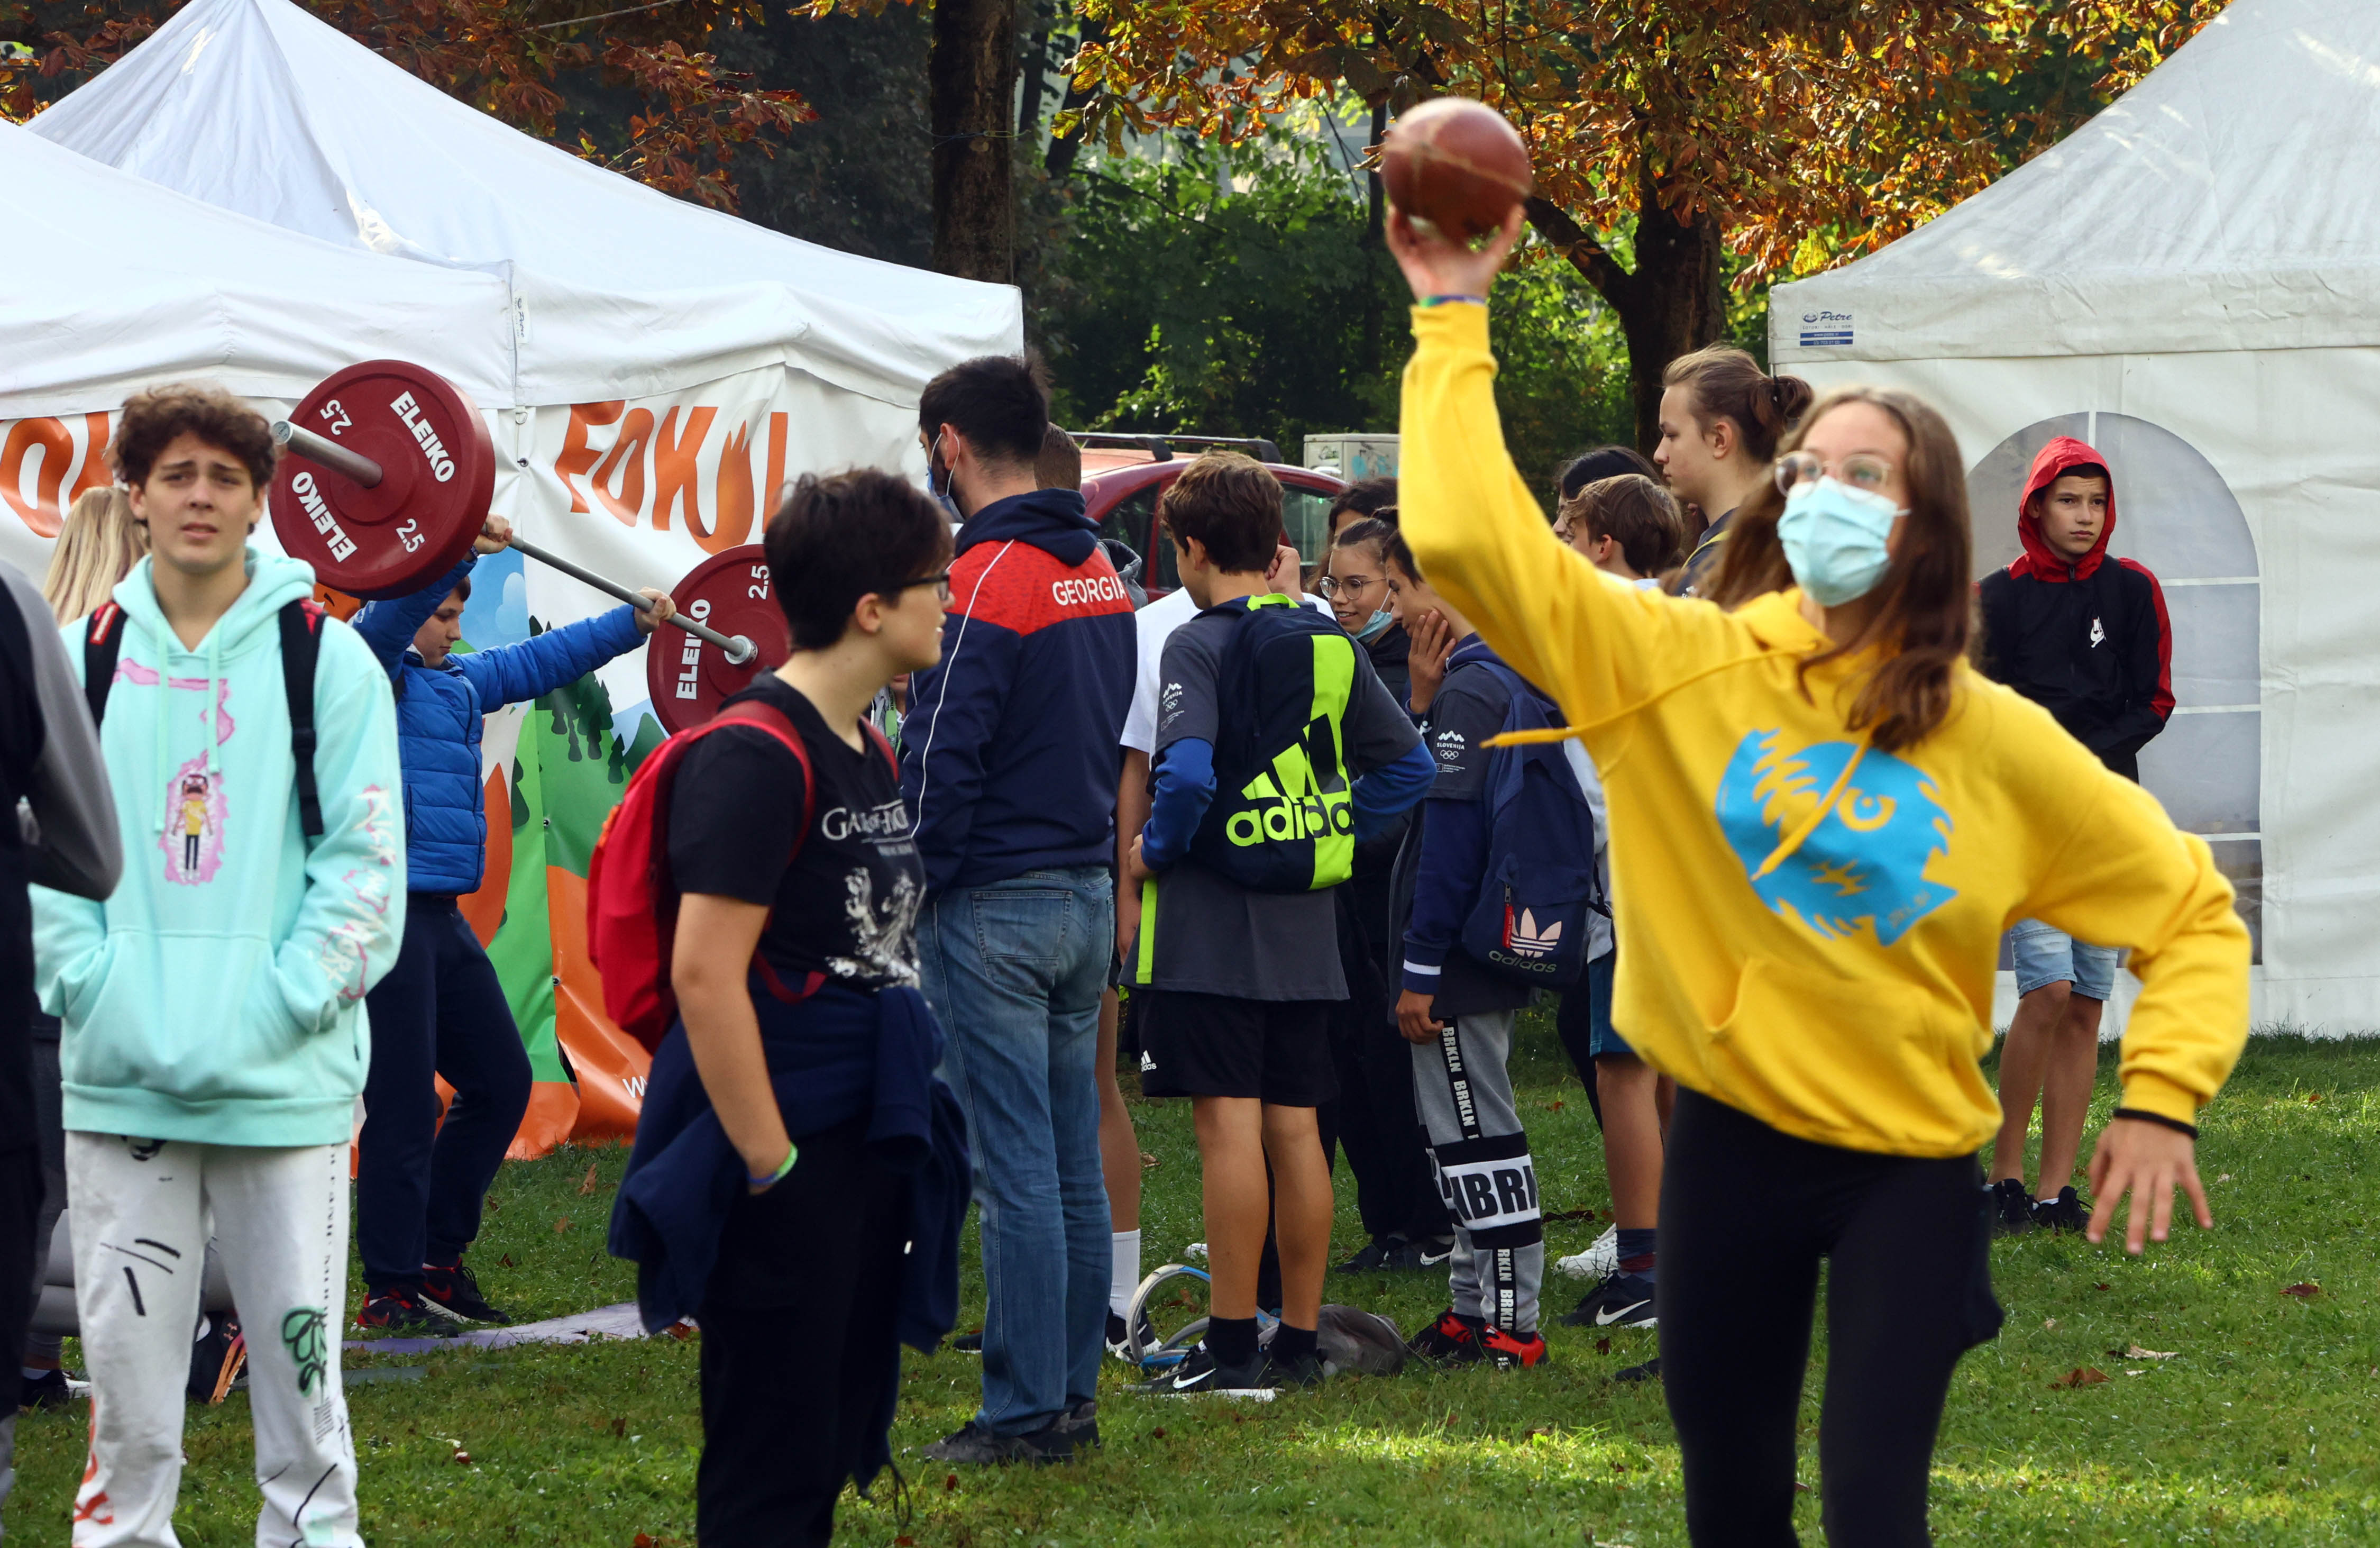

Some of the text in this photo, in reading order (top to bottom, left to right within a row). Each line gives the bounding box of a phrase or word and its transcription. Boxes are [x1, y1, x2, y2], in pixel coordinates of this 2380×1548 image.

[1820, 311, 1852, 322] Petre
[319, 399, 353, 435] 2.5
[390, 390, 455, 482] ELEIKO
[292, 472, 358, 563] ELEIKO
[396, 518, 425, 552] 2.5
[748, 565, 770, 600] 2.5
[1052, 576, 1125, 606] GEORGIA
[1226, 795, 1354, 846] adida
[1489, 950, 1557, 973] adidas
[1442, 1027, 1462, 1072] BRKLN
[1453, 1080, 1476, 1126] BRKLN
[1500, 1289, 1513, 1330] BRKLN
